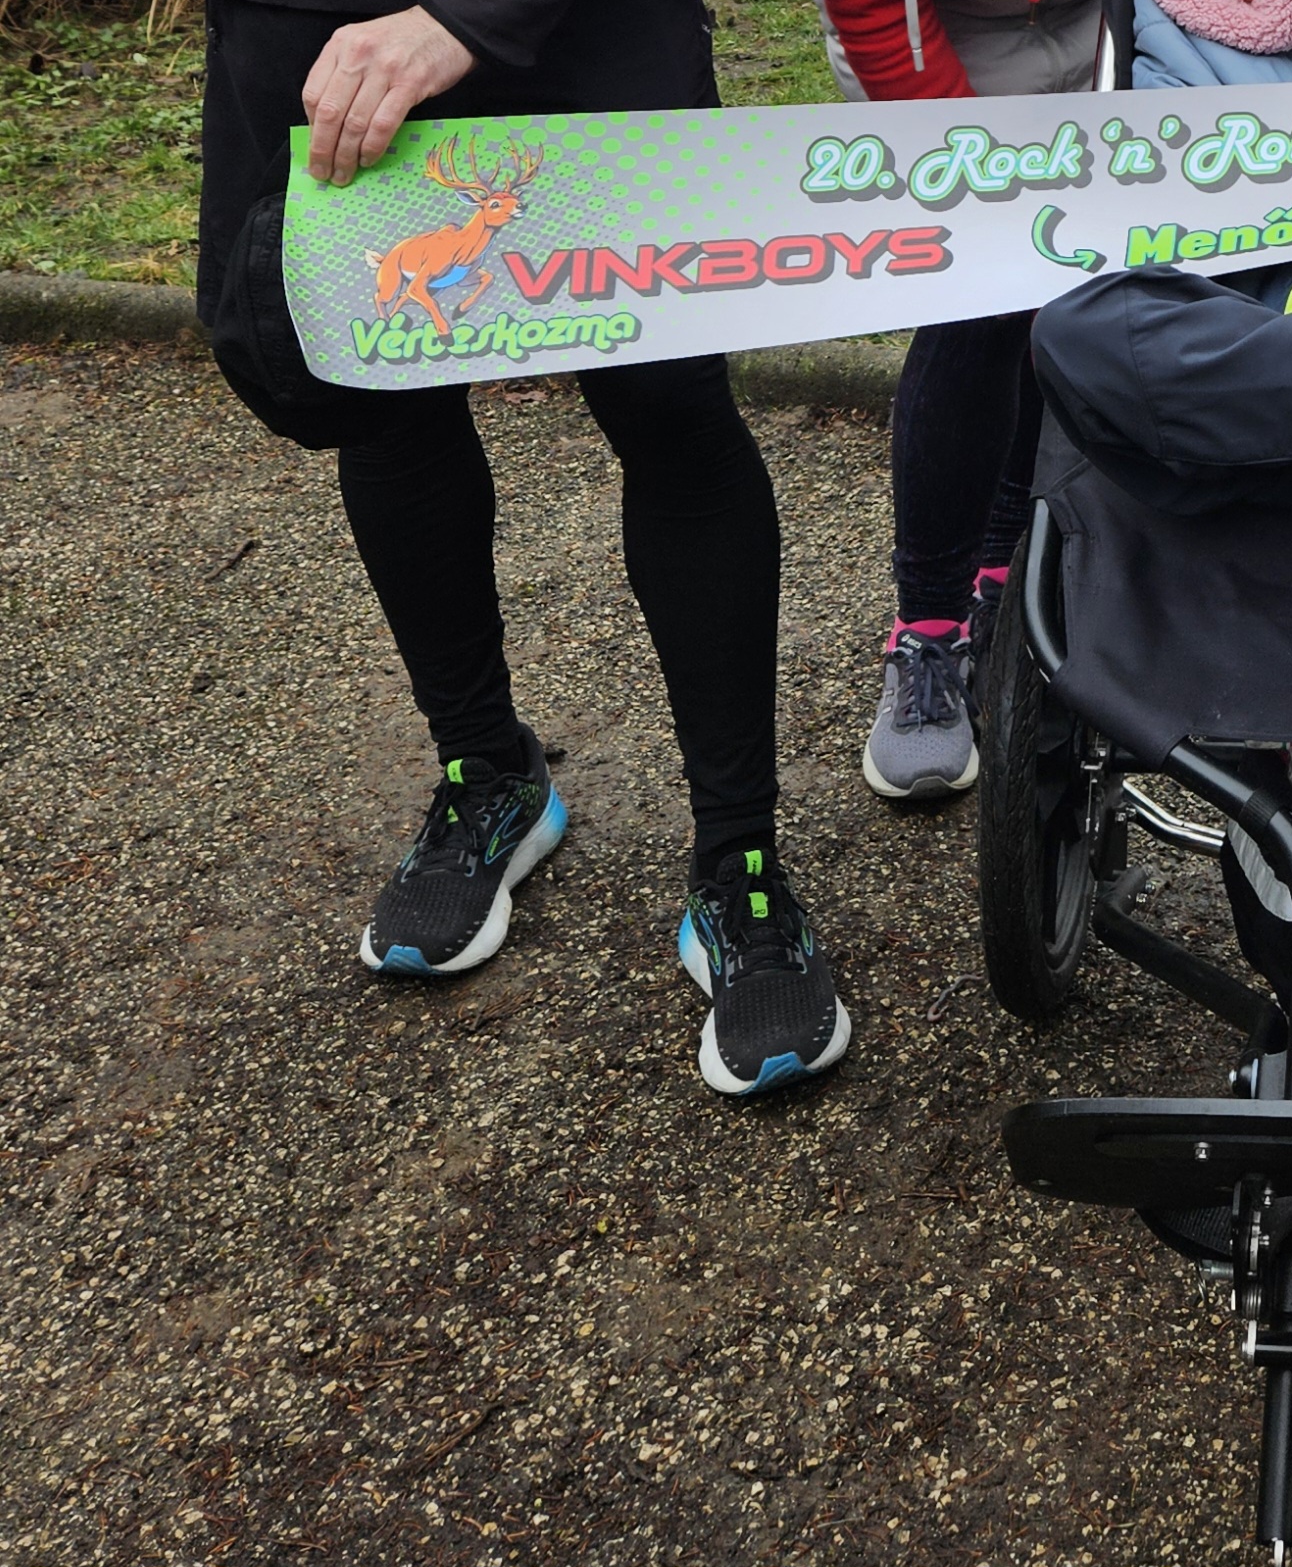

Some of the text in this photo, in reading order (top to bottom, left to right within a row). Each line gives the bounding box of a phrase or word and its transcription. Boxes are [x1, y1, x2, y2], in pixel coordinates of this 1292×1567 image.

[801, 135, 900, 196] 20.
[907, 120, 1090, 206] Rock
[500, 225, 951, 301] VINKBOYS
[351, 311, 641, 363] Vérteskozma
